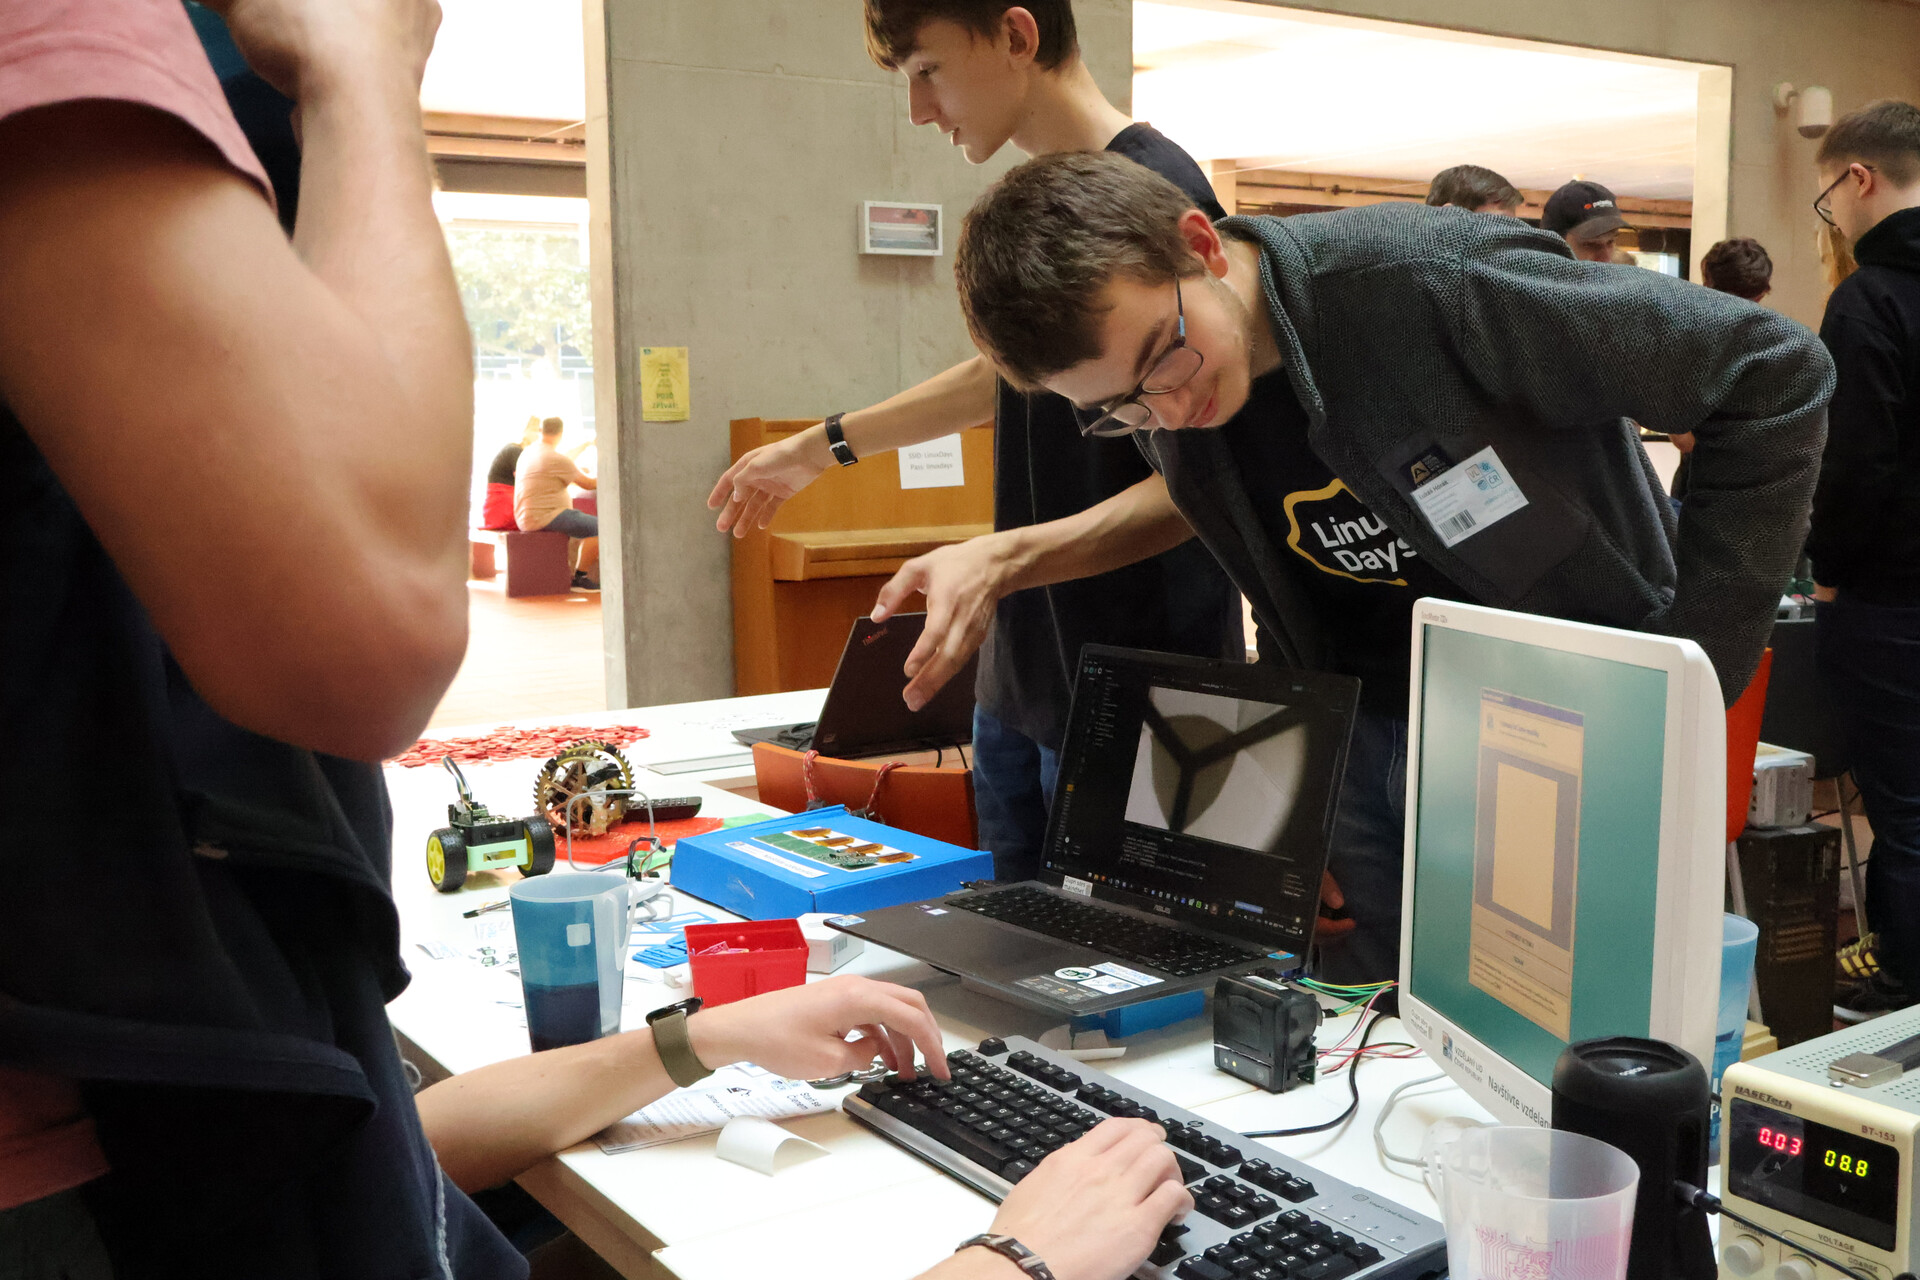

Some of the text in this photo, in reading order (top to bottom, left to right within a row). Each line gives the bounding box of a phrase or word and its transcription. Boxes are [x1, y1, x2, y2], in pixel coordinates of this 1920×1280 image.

[1311, 515, 1388, 549] Linu
[1861, 1125, 1896, 1143] BT-153
[1817, 1232, 1856, 1252] VOLTAGE
